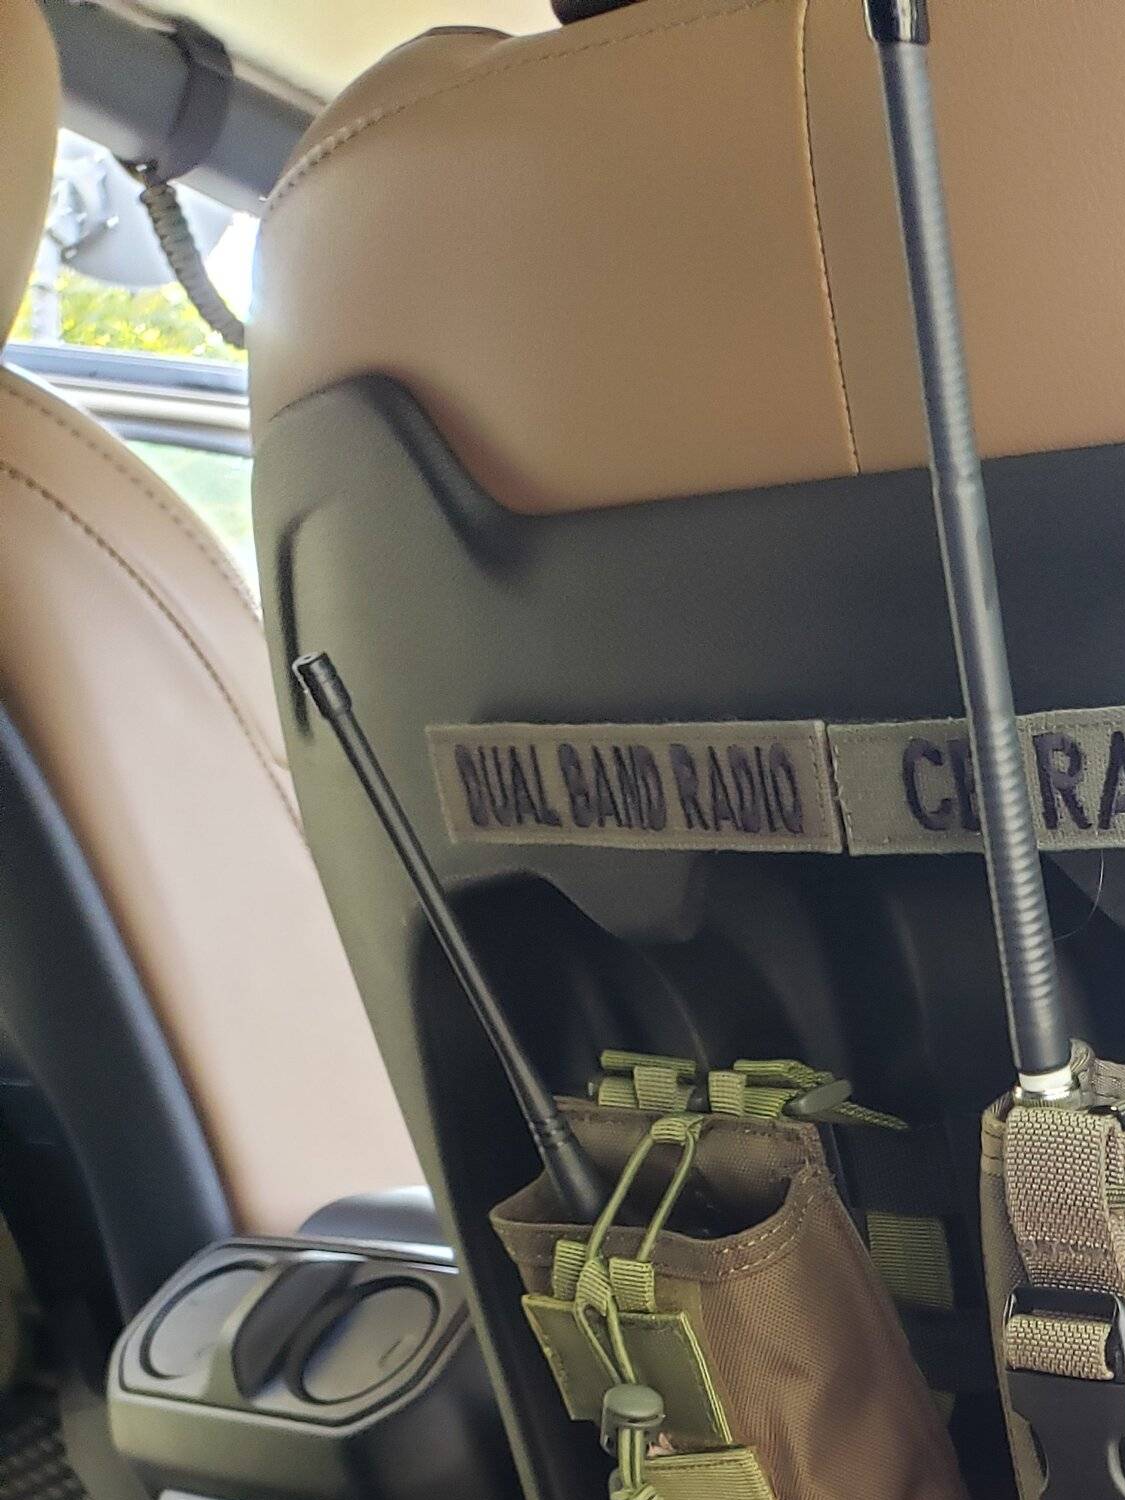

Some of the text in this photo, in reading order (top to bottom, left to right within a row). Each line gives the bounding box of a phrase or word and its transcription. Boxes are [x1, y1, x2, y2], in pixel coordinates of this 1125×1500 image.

[454, 742, 803, 834] DUAL BAND RADIO
